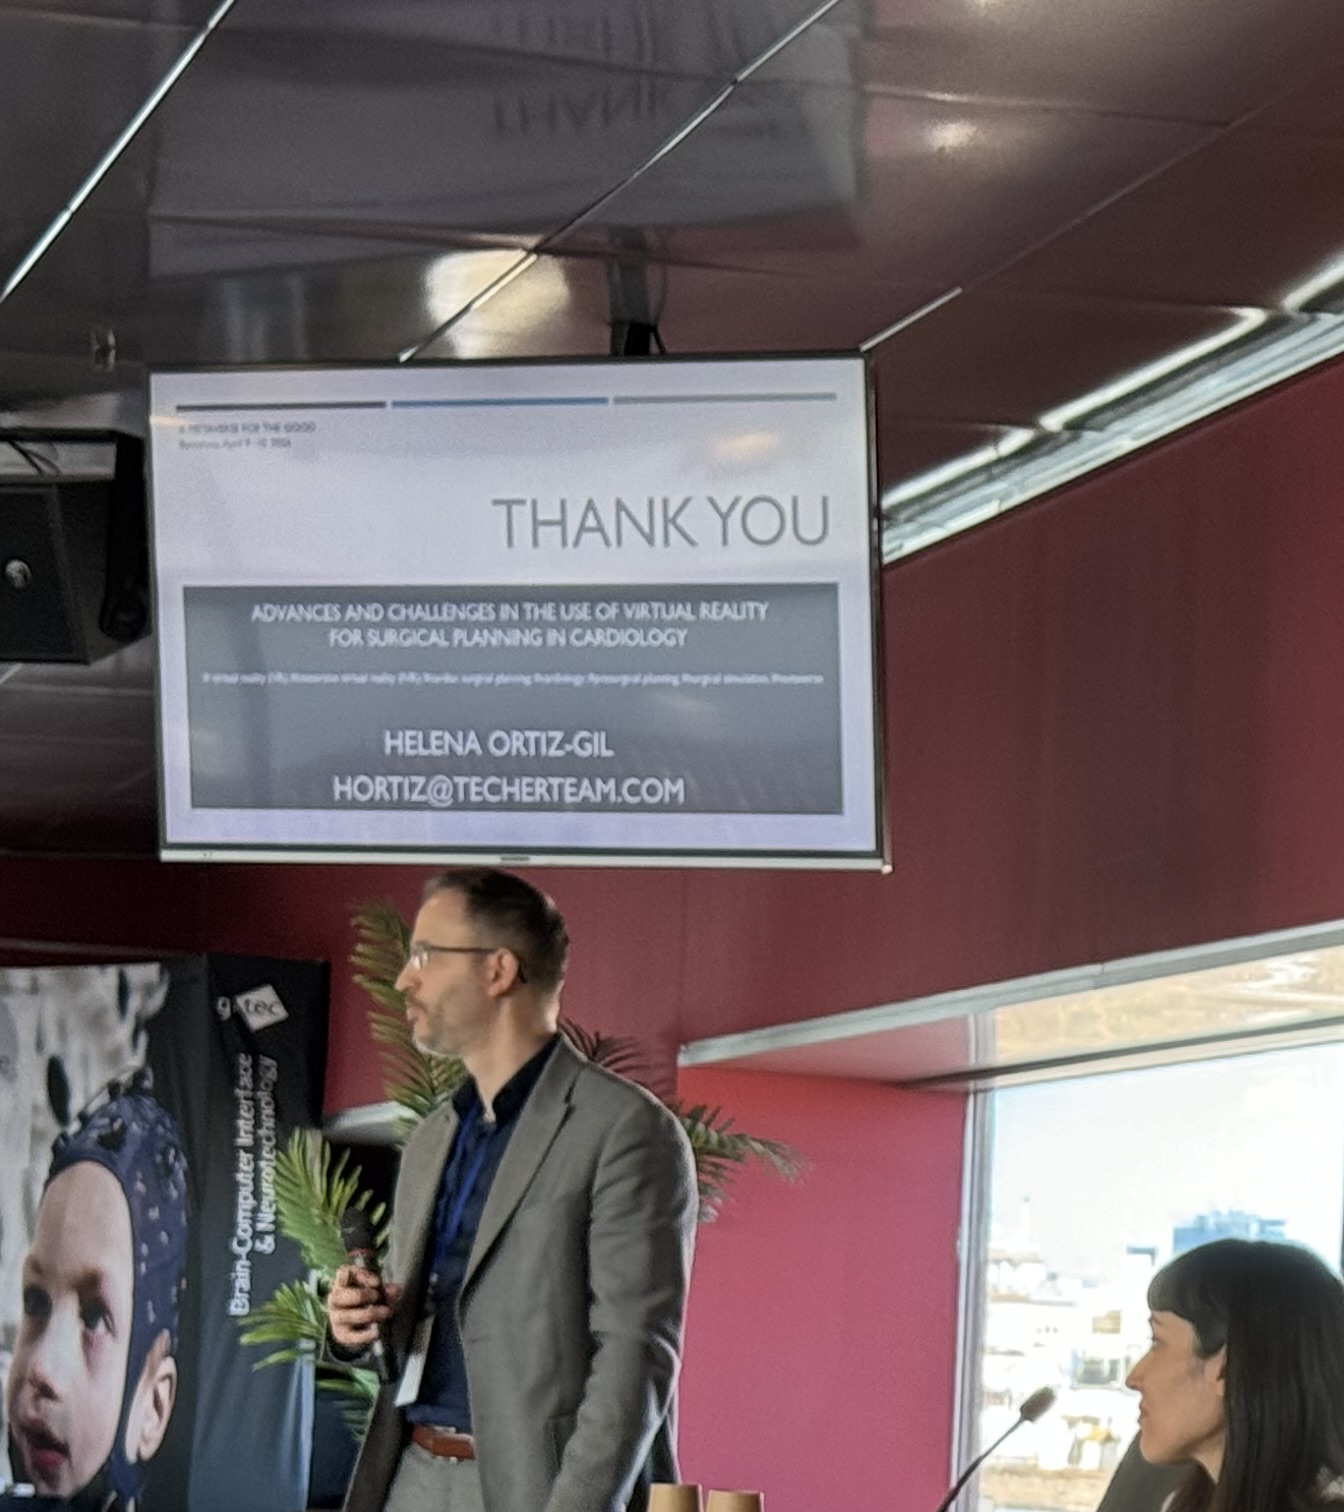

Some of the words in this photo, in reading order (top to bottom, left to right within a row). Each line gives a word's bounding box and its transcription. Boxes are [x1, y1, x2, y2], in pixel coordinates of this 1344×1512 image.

[492, 496, 699, 549] THANK
[707, 494, 830, 547] YOU
[251, 603, 341, 622] ADVANCES
[345, 603, 385, 621] AND
[388, 602, 497, 621] CHALLENGES
[500, 602, 519, 621] IN
[523, 602, 556, 621] THE
[560, 601, 592, 621] USE
[595, 601, 620, 621] OF
[623, 601, 697, 621] VIRTUAL
[700, 601, 769, 621] REALITY
[329, 628, 364, 647] FOR
[368, 628, 449, 647] SURGICAL
[453, 628, 543, 647] PLANNING
[547, 628, 566, 647] IN
[569, 627, 688, 647] CARDIOLOGY
[384, 730, 483, 757] HELENA
[488, 730, 615, 757] ORTIZ-GIL
[333, 775, 685, 807] HORTIZ@TECHERTEAM.COM
[234, 1053, 255, 1147] Interface
[256, 1054, 277, 1232] Neurotechnology
[229, 1150, 257, 1316] Brain-Computer
